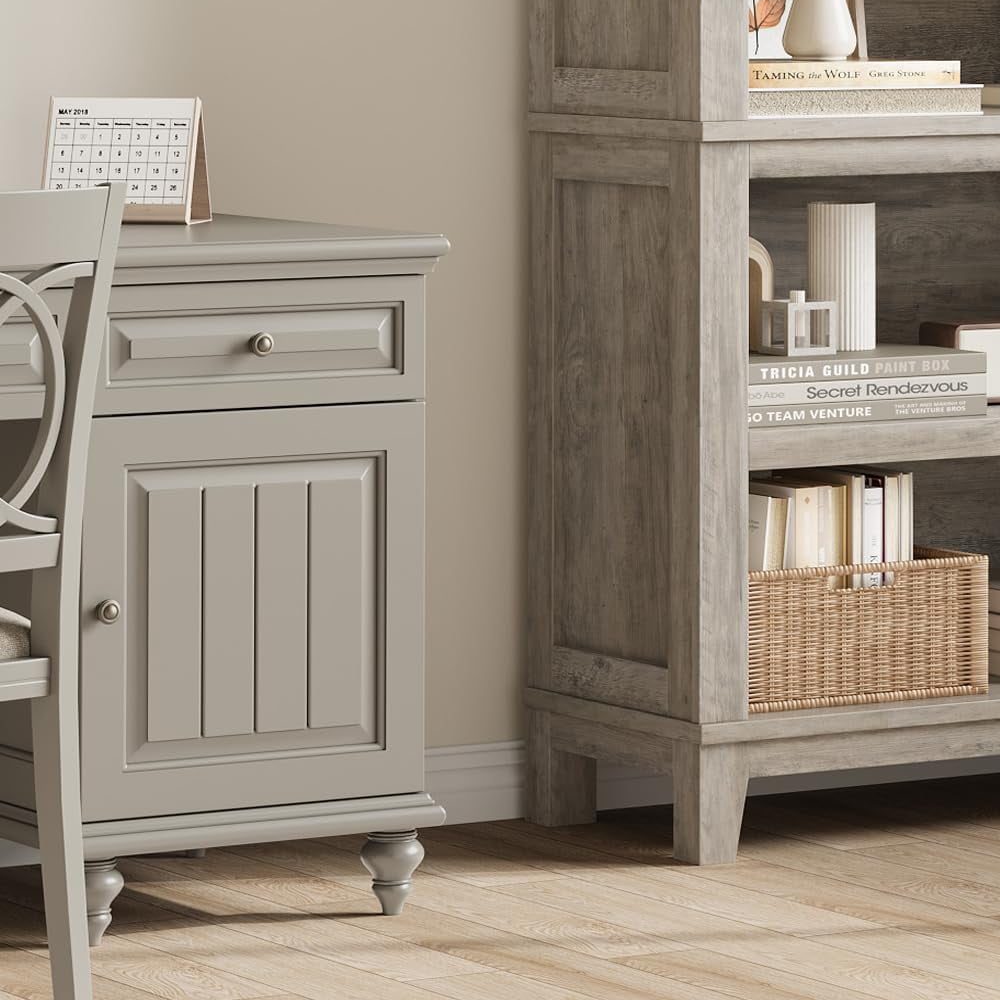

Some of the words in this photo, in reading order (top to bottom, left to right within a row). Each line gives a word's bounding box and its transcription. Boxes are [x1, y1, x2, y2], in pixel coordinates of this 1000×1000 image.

[752, 70, 804, 80] TAMING
[808, 71, 822, 79] the
[824, 69, 860, 79] WOLF
[897, 69, 926, 77] STONE
[760, 366, 815, 380] TRICIA
[823, 363, 870, 376] GUILD
[875, 361, 916, 374] PAINT
[922, 359, 950, 372] BOX
[806, 384, 860, 399] Secret
[866, 381, 969, 397] Rendezvous
[766, 410, 805, 421] TEAM
[810, 407, 872, 419] VENTURE
